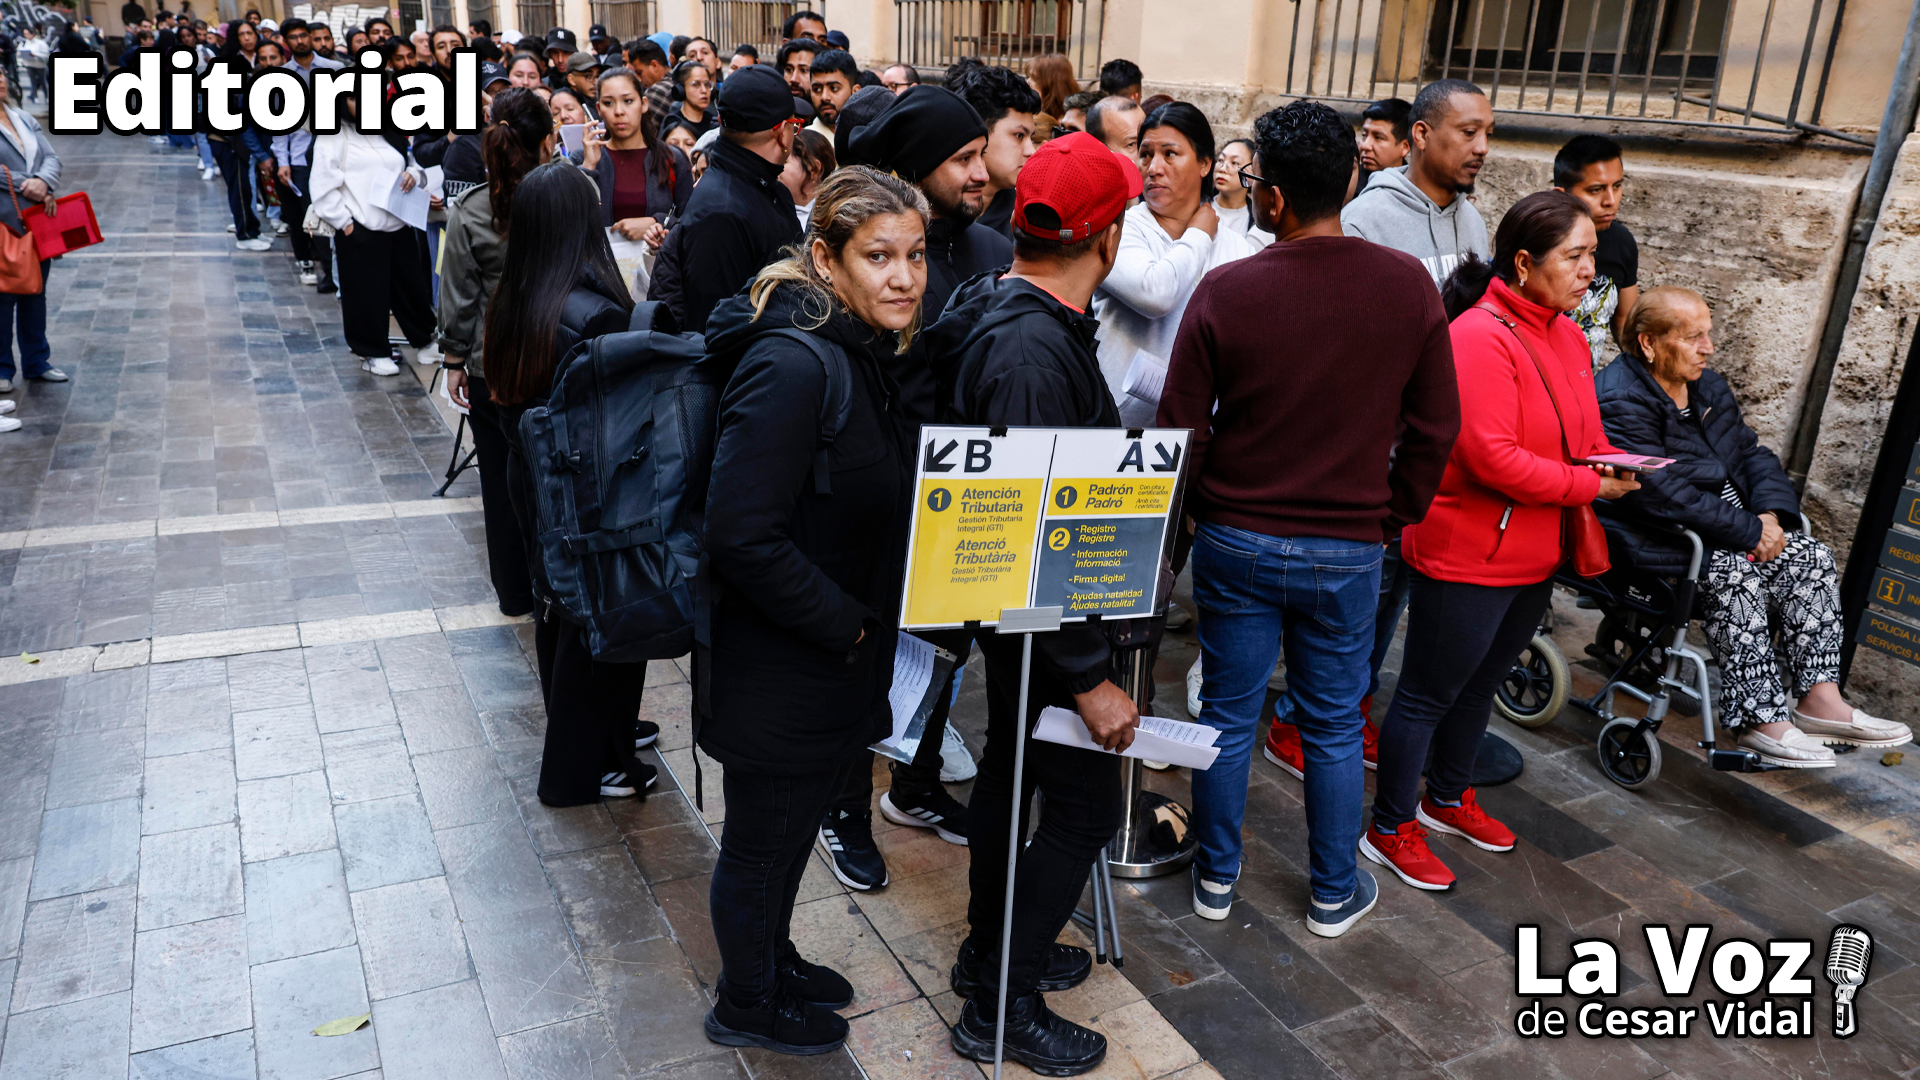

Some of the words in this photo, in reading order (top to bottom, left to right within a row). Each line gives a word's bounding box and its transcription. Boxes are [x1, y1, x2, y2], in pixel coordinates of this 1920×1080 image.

[964, 439, 992, 473] B
[1116, 441, 1144, 472] A
[961, 487, 1021, 500] Atención
[1088, 484, 1134, 496] Padrón
[934, 490, 943, 508] 1
[1061, 488, 1070, 506] 1
[1085, 497, 1123, 509] Padró
[960, 501, 1023, 514] Tributaria
[958, 514, 987, 524] Gestión
[989, 514, 1023, 522] Tributaria
[957, 525, 985, 534] Integral
[986, 524, 1004, 532] (GTI)
[955, 537, 1006, 551] Atenció
[1053, 531, 1066, 548] 2
[1078, 534, 1115, 545] Registre
[954, 551, 1017, 565] Tributària
[1888, 546, 1920, 564] REGIS
[1075, 558, 1121, 568] Informació
[951, 566, 976, 575] Gestió
[977, 566, 1012, 574] Tributària
[950, 576, 979, 584] Integral
[979, 574, 998, 583] (GTI)
[1100, 573, 1126, 584] digital
[1105, 588, 1144, 599] natalidad
[1069, 601, 1100, 612] Ajudes
[1100, 598, 1135, 609] natalitat
[1870, 618, 1910, 640] POLICIA
[1865, 634, 1912, 658] SERVICIS
